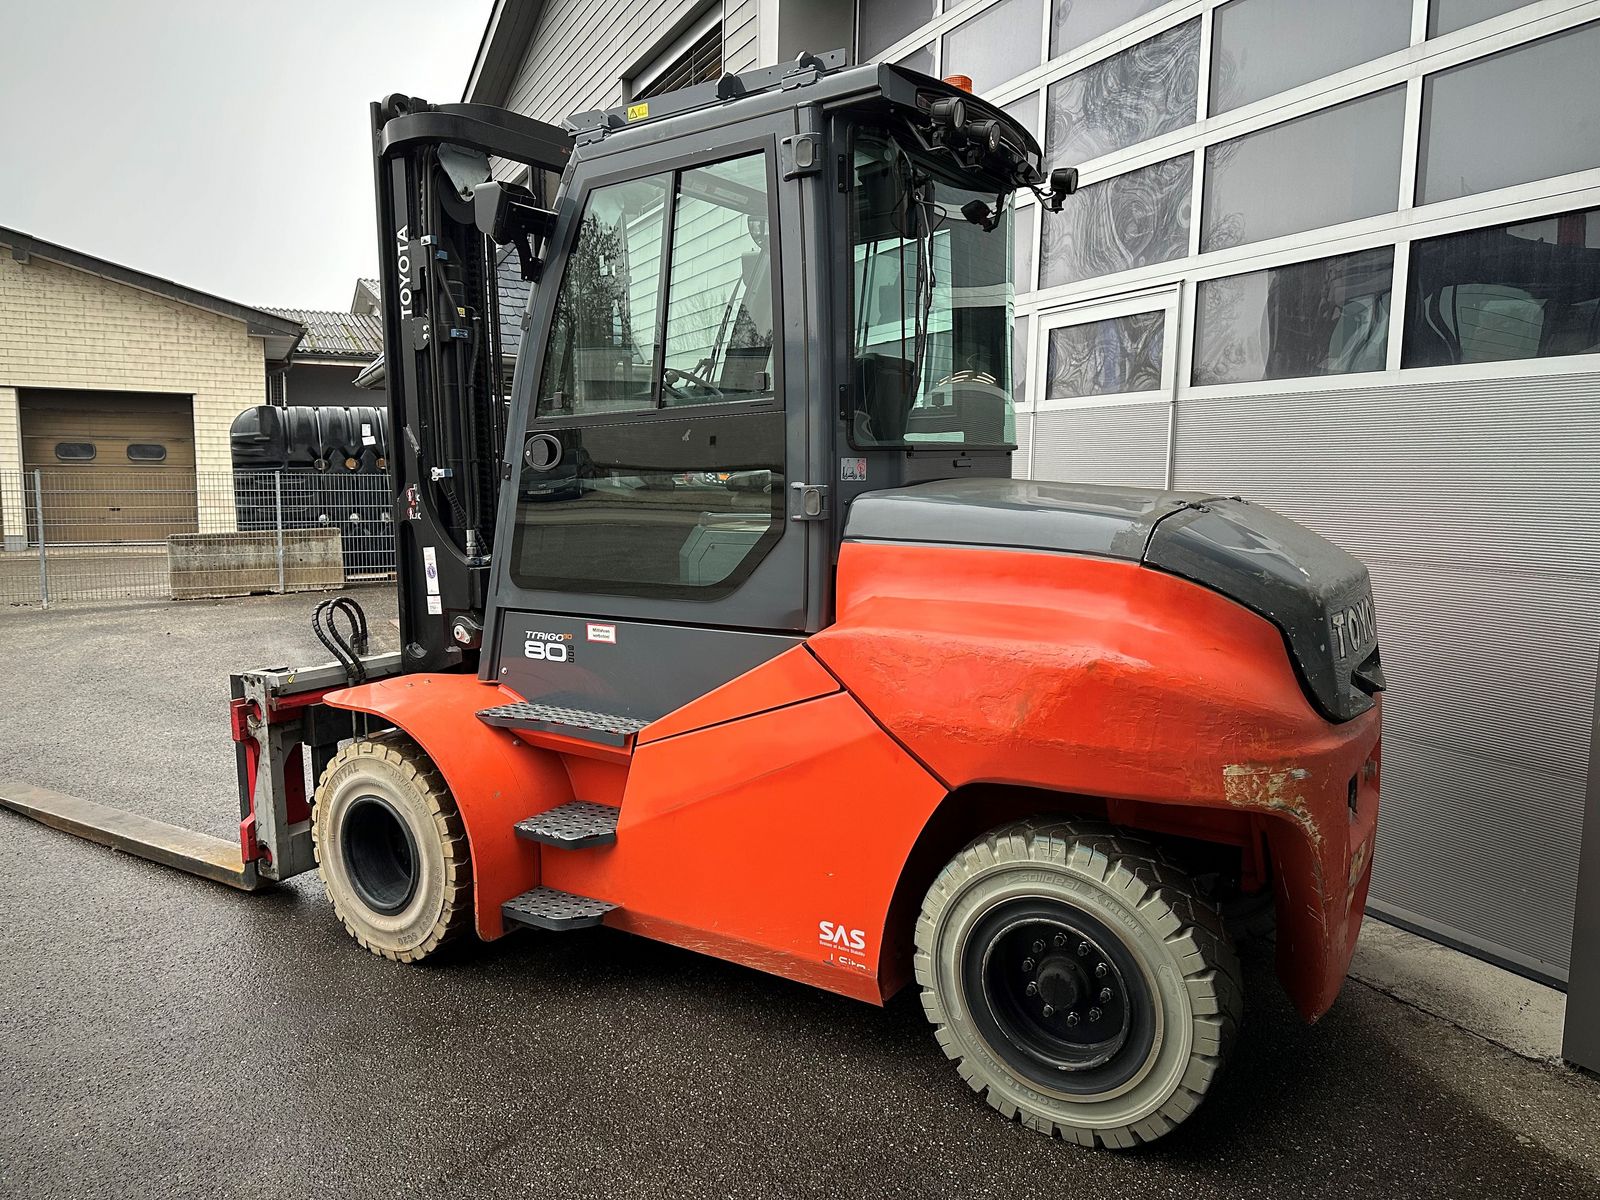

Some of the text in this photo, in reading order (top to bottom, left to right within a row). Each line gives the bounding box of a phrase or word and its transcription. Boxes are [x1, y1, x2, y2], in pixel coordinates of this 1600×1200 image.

[397, 224, 413, 320] TOYOTA
[524, 640, 567, 662] 80
[819, 920, 866, 950] SAS
